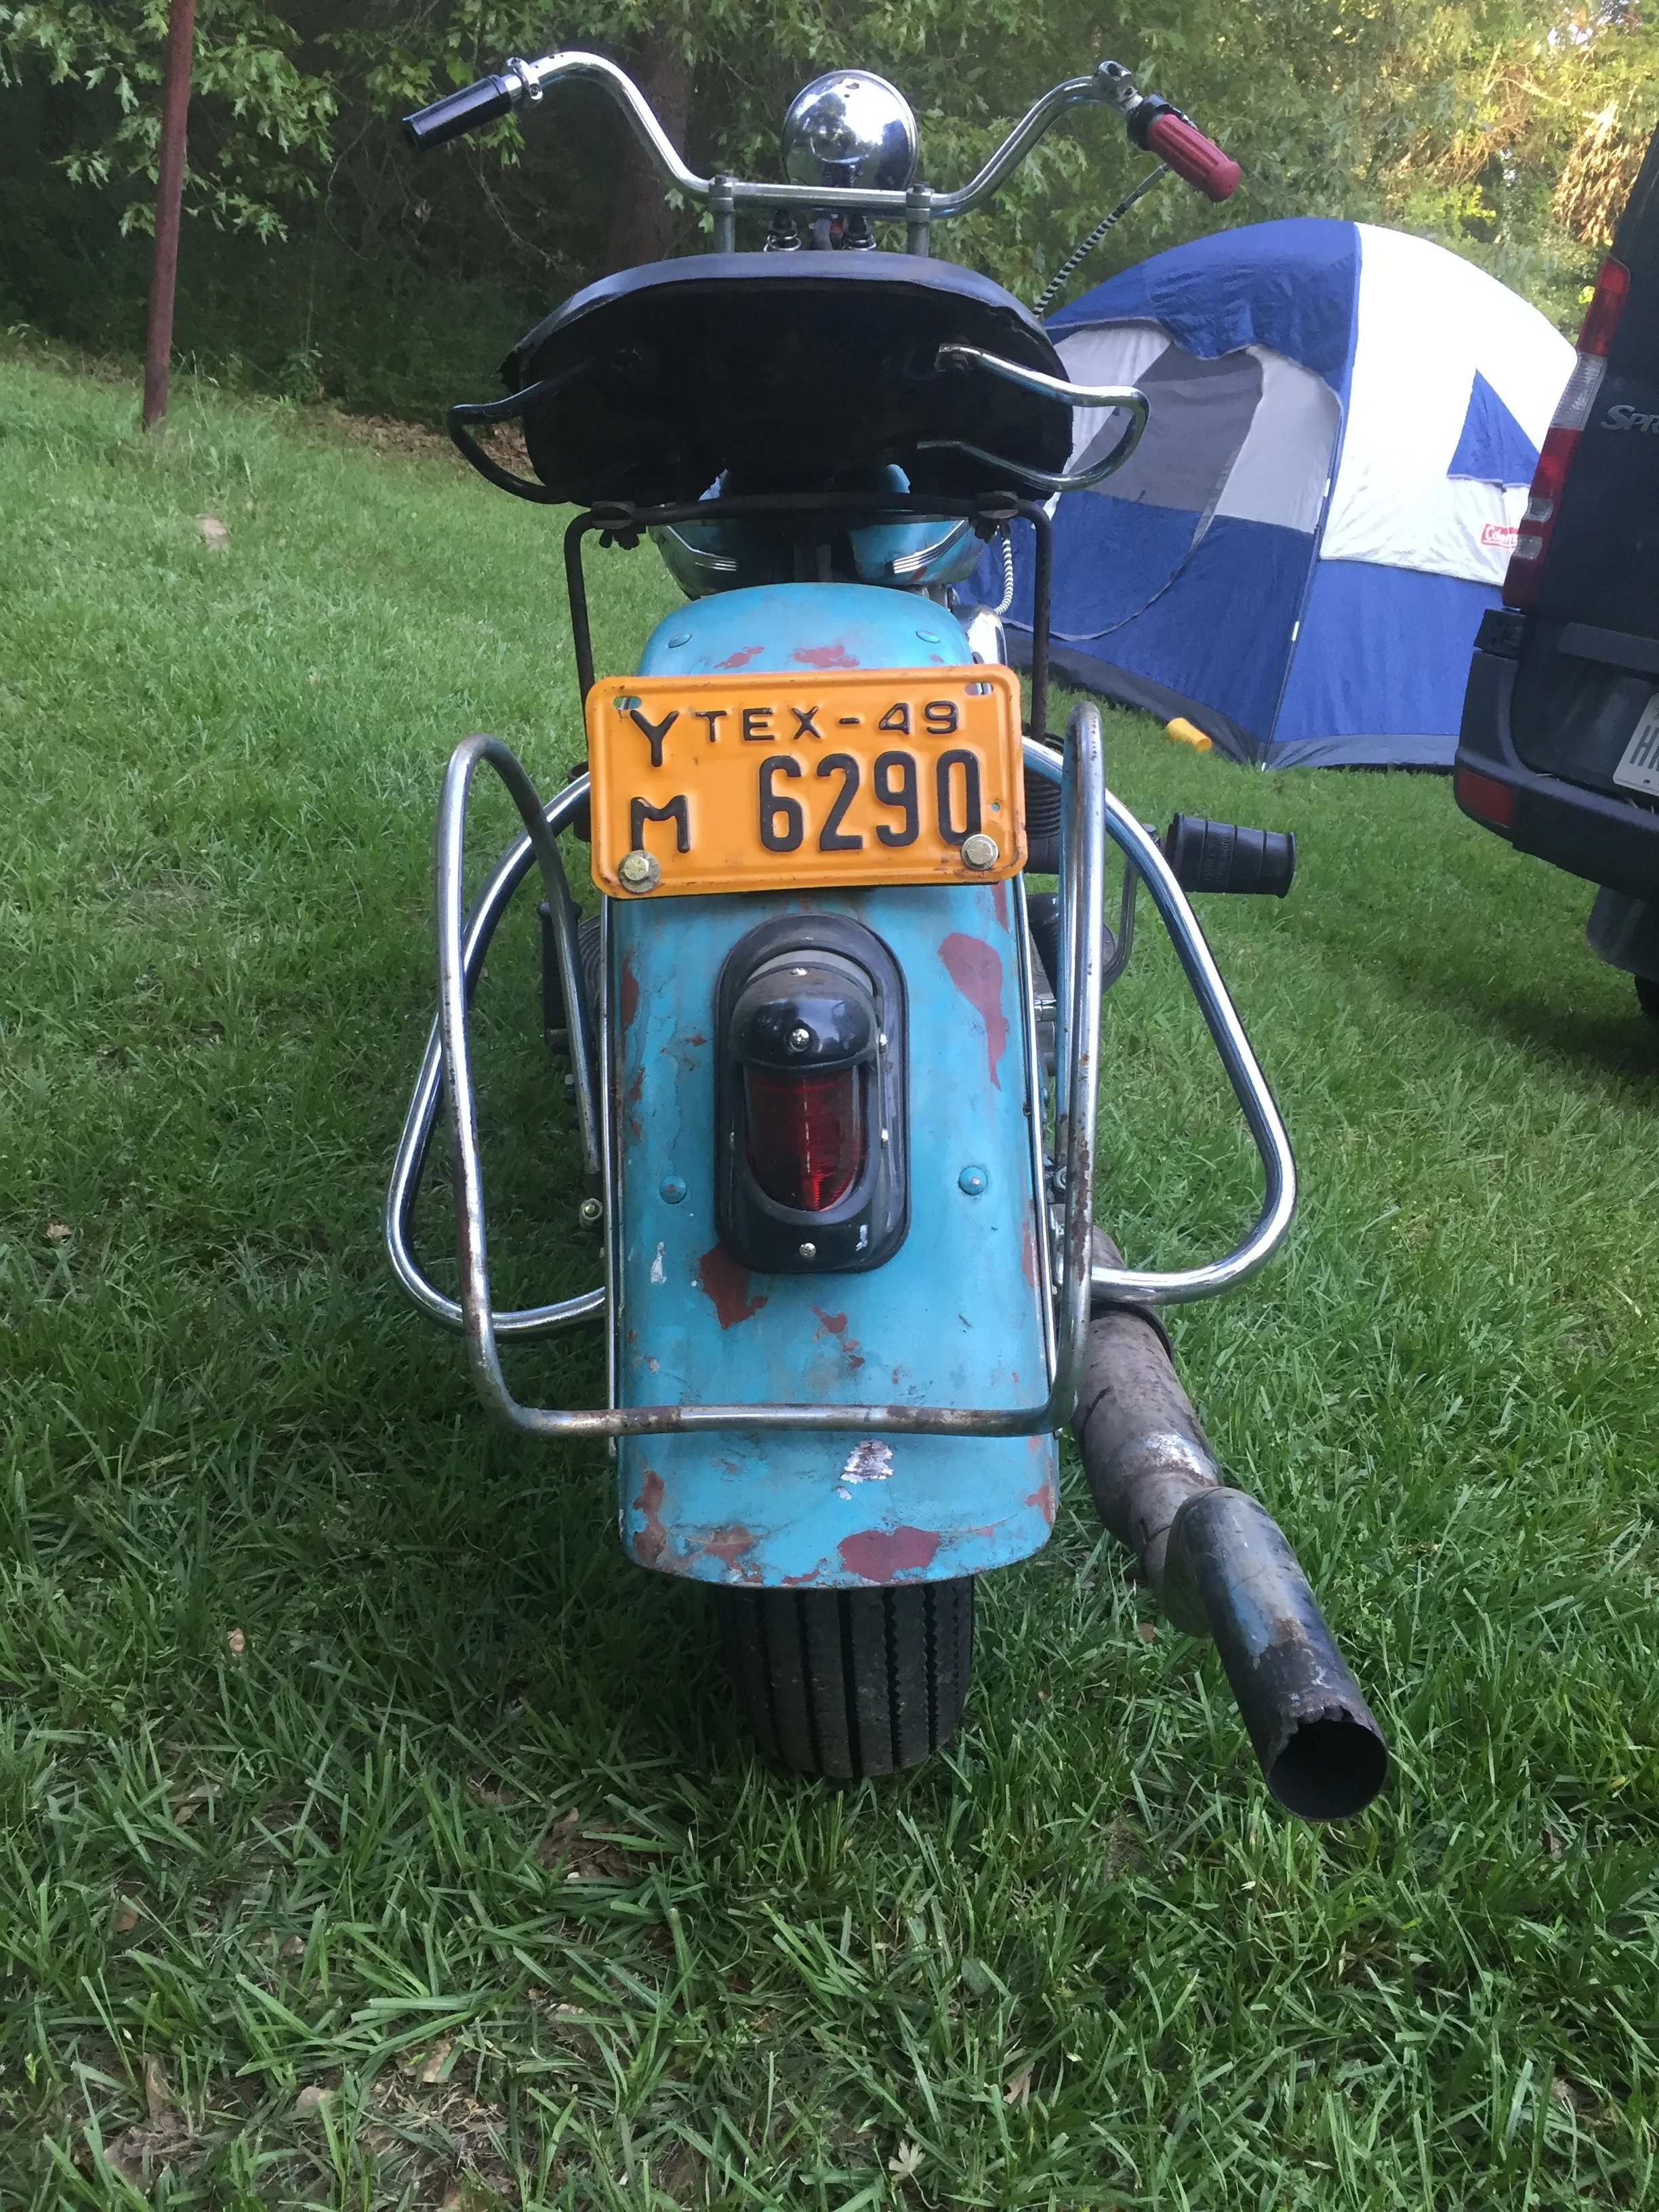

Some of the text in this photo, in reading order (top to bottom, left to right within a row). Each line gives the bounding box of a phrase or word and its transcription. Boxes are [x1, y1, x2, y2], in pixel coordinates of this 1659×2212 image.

[1485, 525, 1519, 545] Colem
[629, 709, 680, 768] Y
[695, 700, 959, 743] TEX-49
[630, 794, 691, 854] M
[758, 749, 981, 852] 6290
